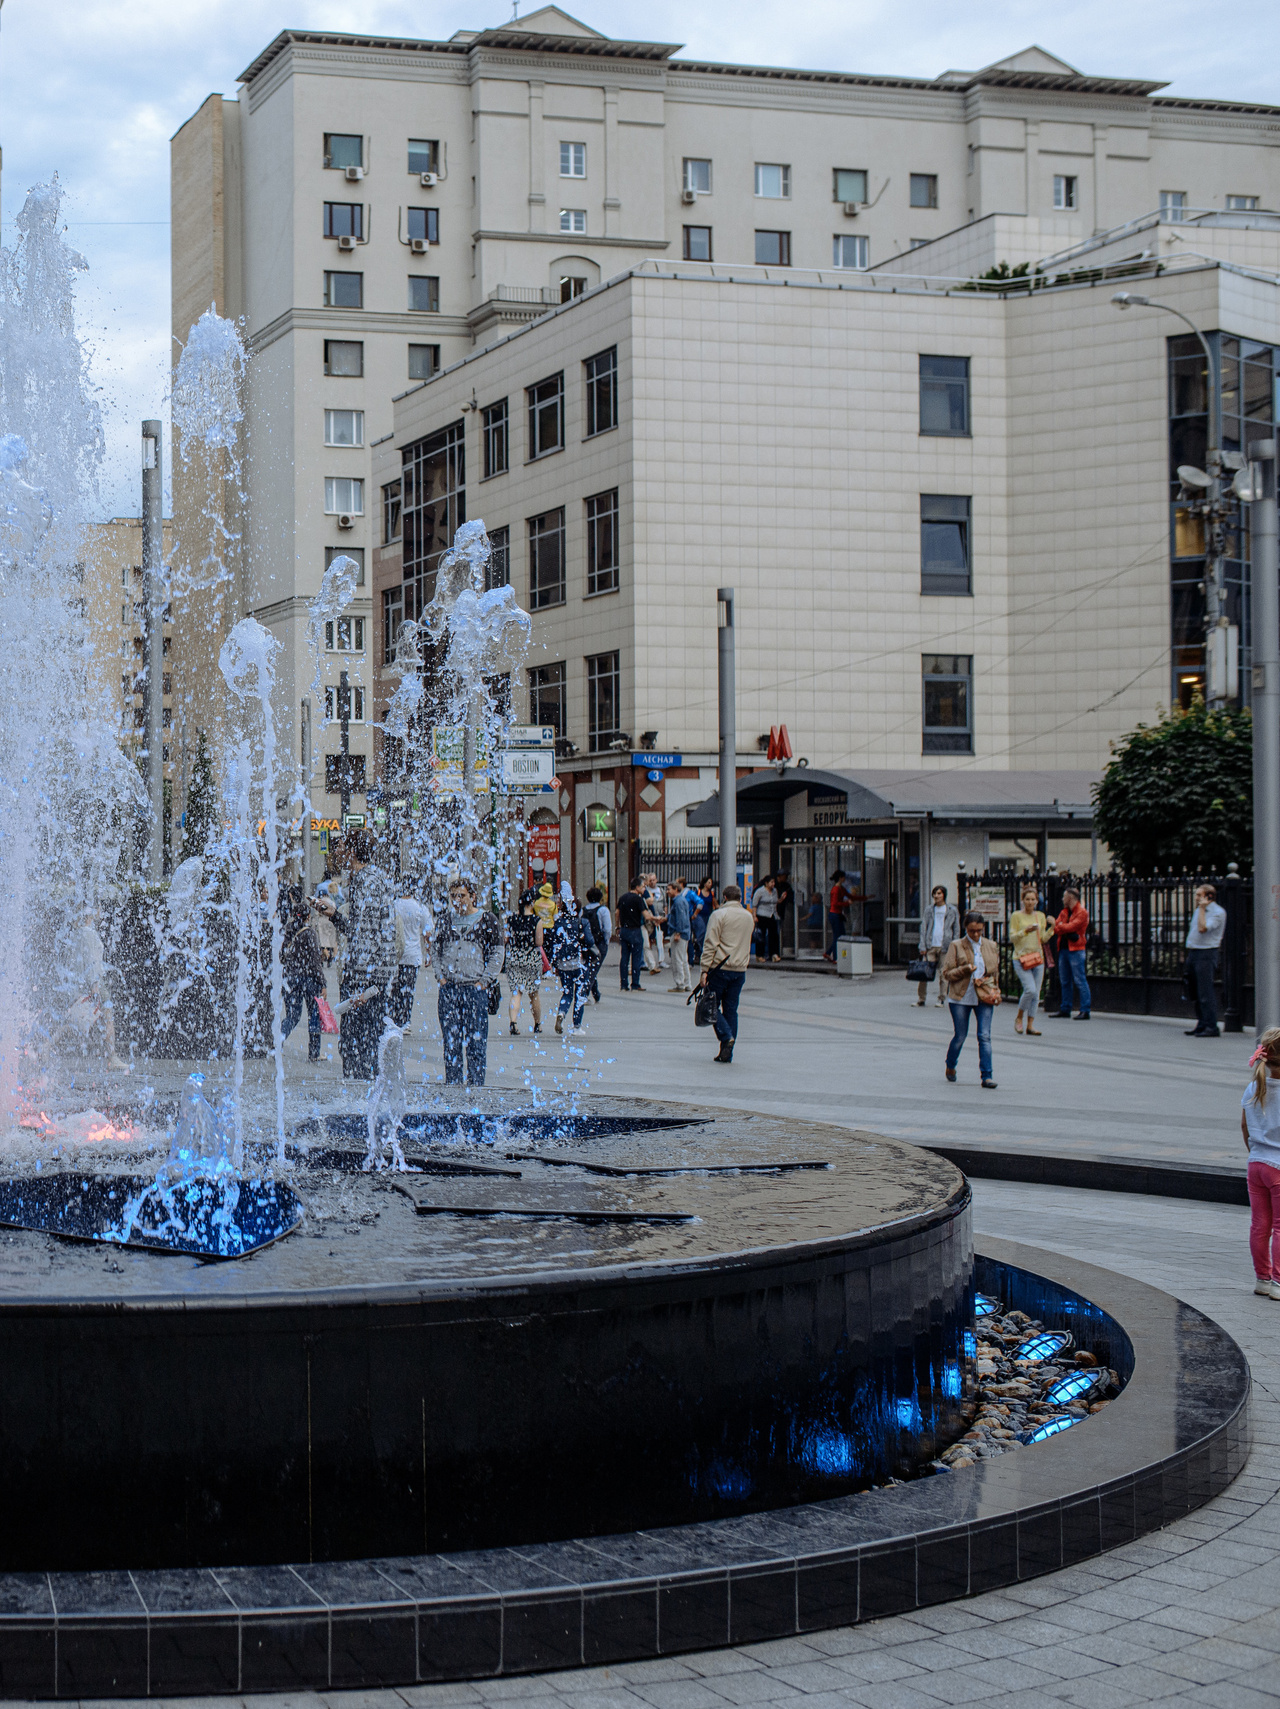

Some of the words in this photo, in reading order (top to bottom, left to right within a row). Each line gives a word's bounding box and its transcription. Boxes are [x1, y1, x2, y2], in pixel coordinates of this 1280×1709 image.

[642, 755, 674, 764] ЛЕСНАЯ
[512, 759, 540, 773] BOSTON
[652, 770, 660, 782] 3
